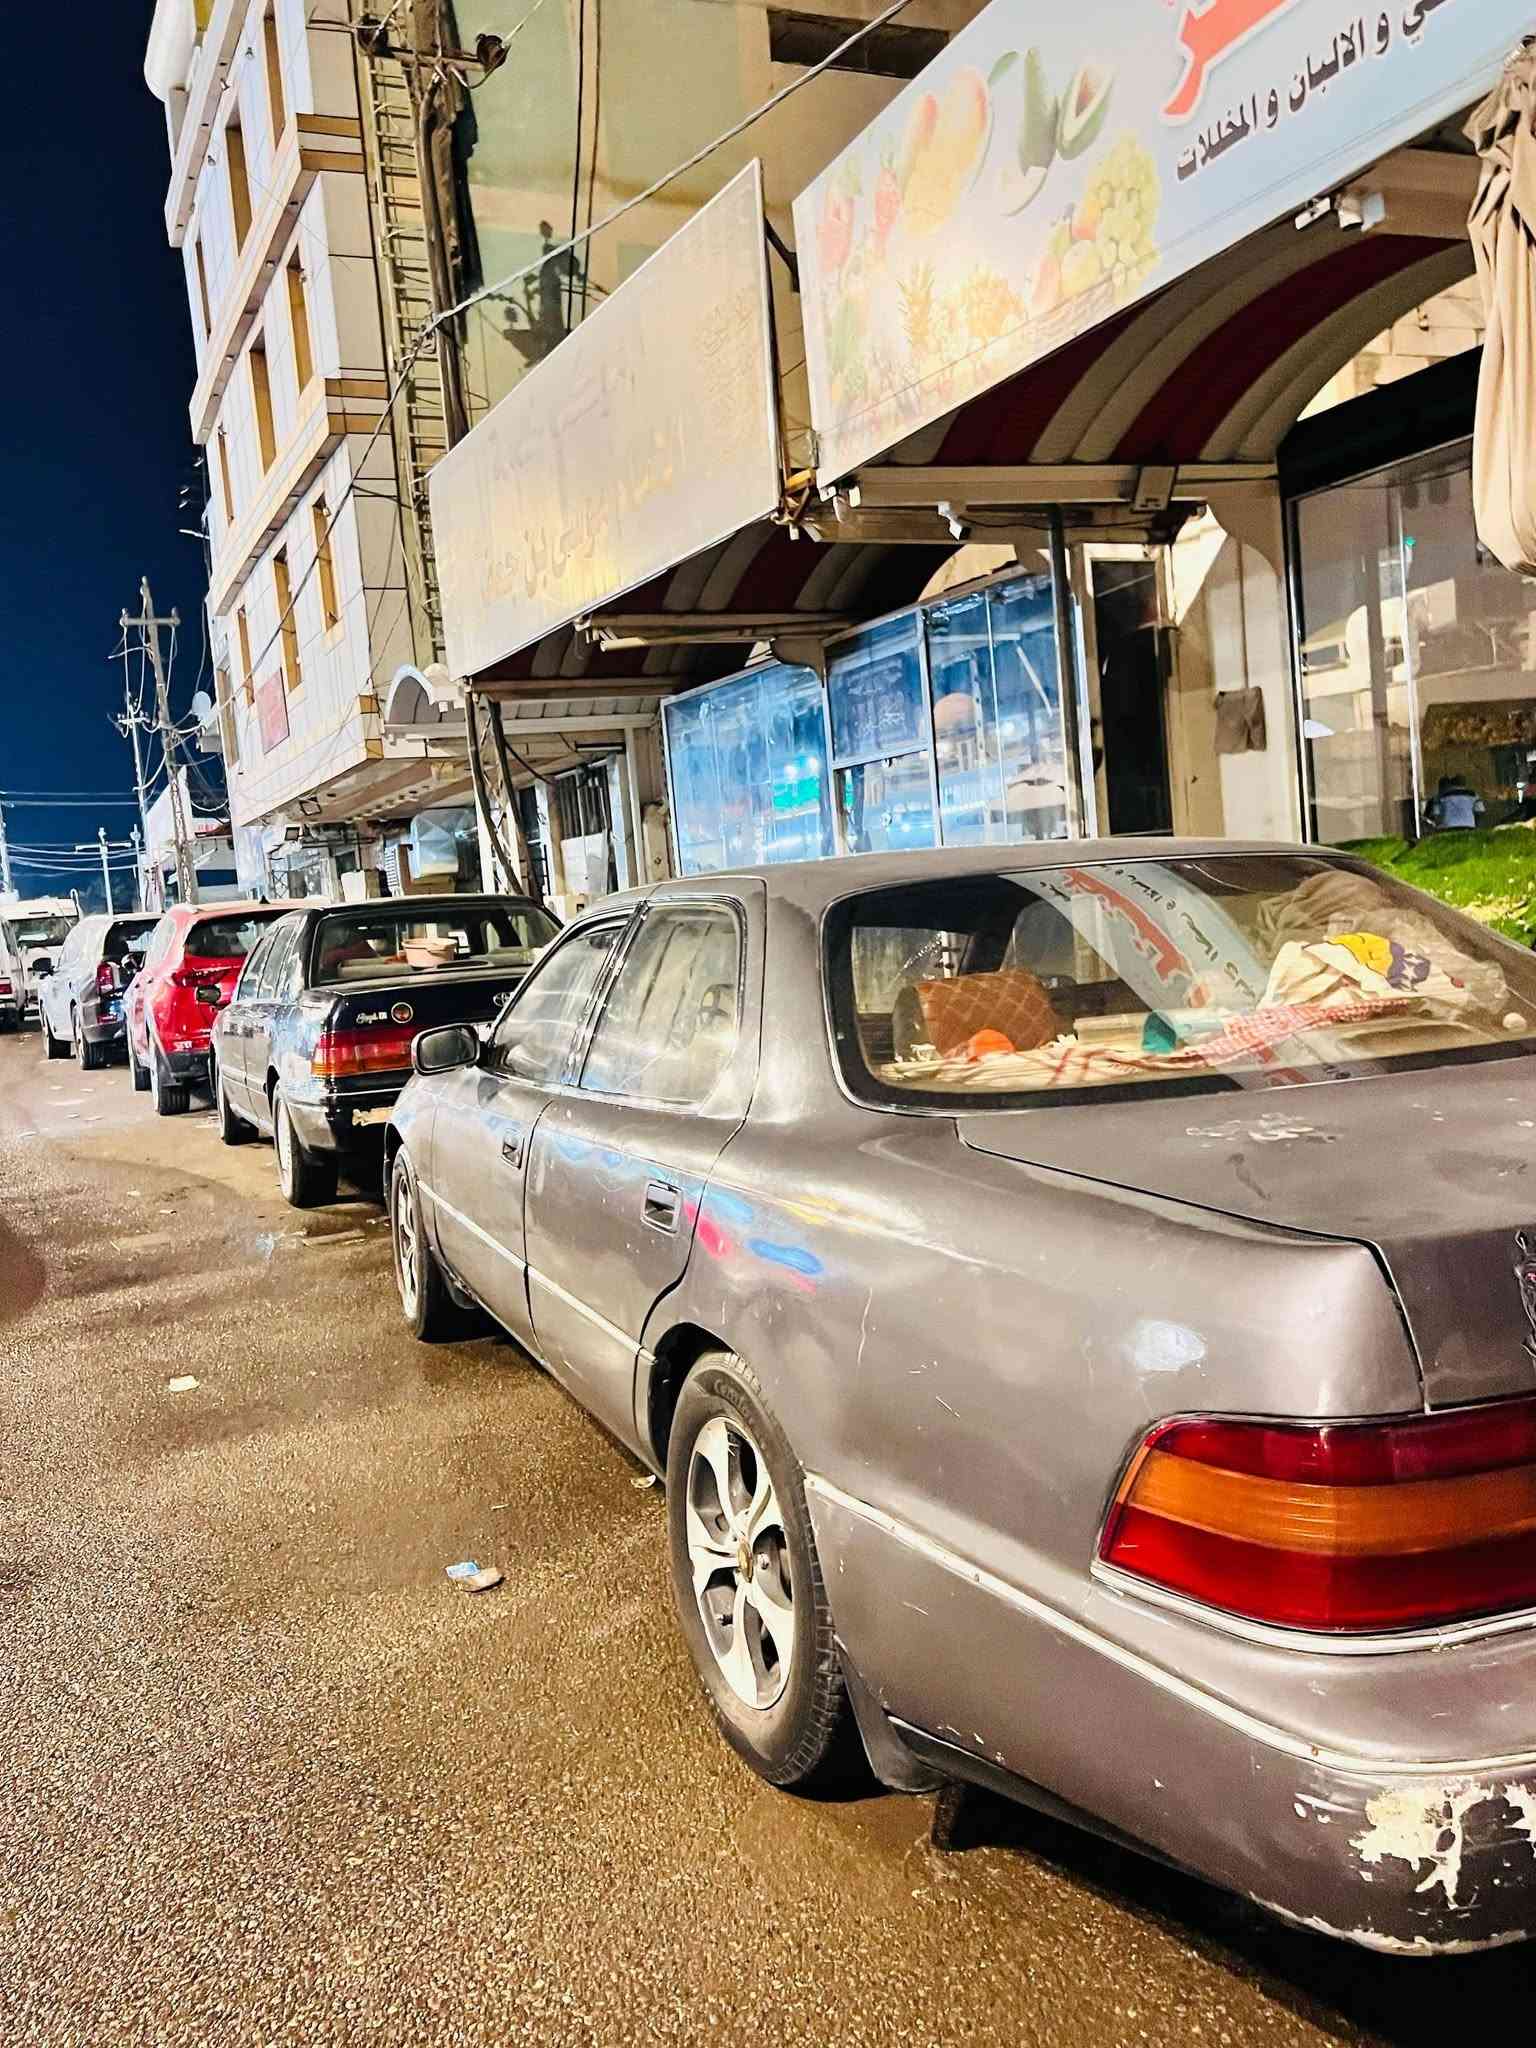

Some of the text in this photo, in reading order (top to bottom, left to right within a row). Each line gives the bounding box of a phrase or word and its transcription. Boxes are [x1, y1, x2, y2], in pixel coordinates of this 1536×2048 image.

[1376, 12, 1390, 55] و
[1266, 88, 1279, 128] و
[1176, 92, 1257, 181] المخللات
